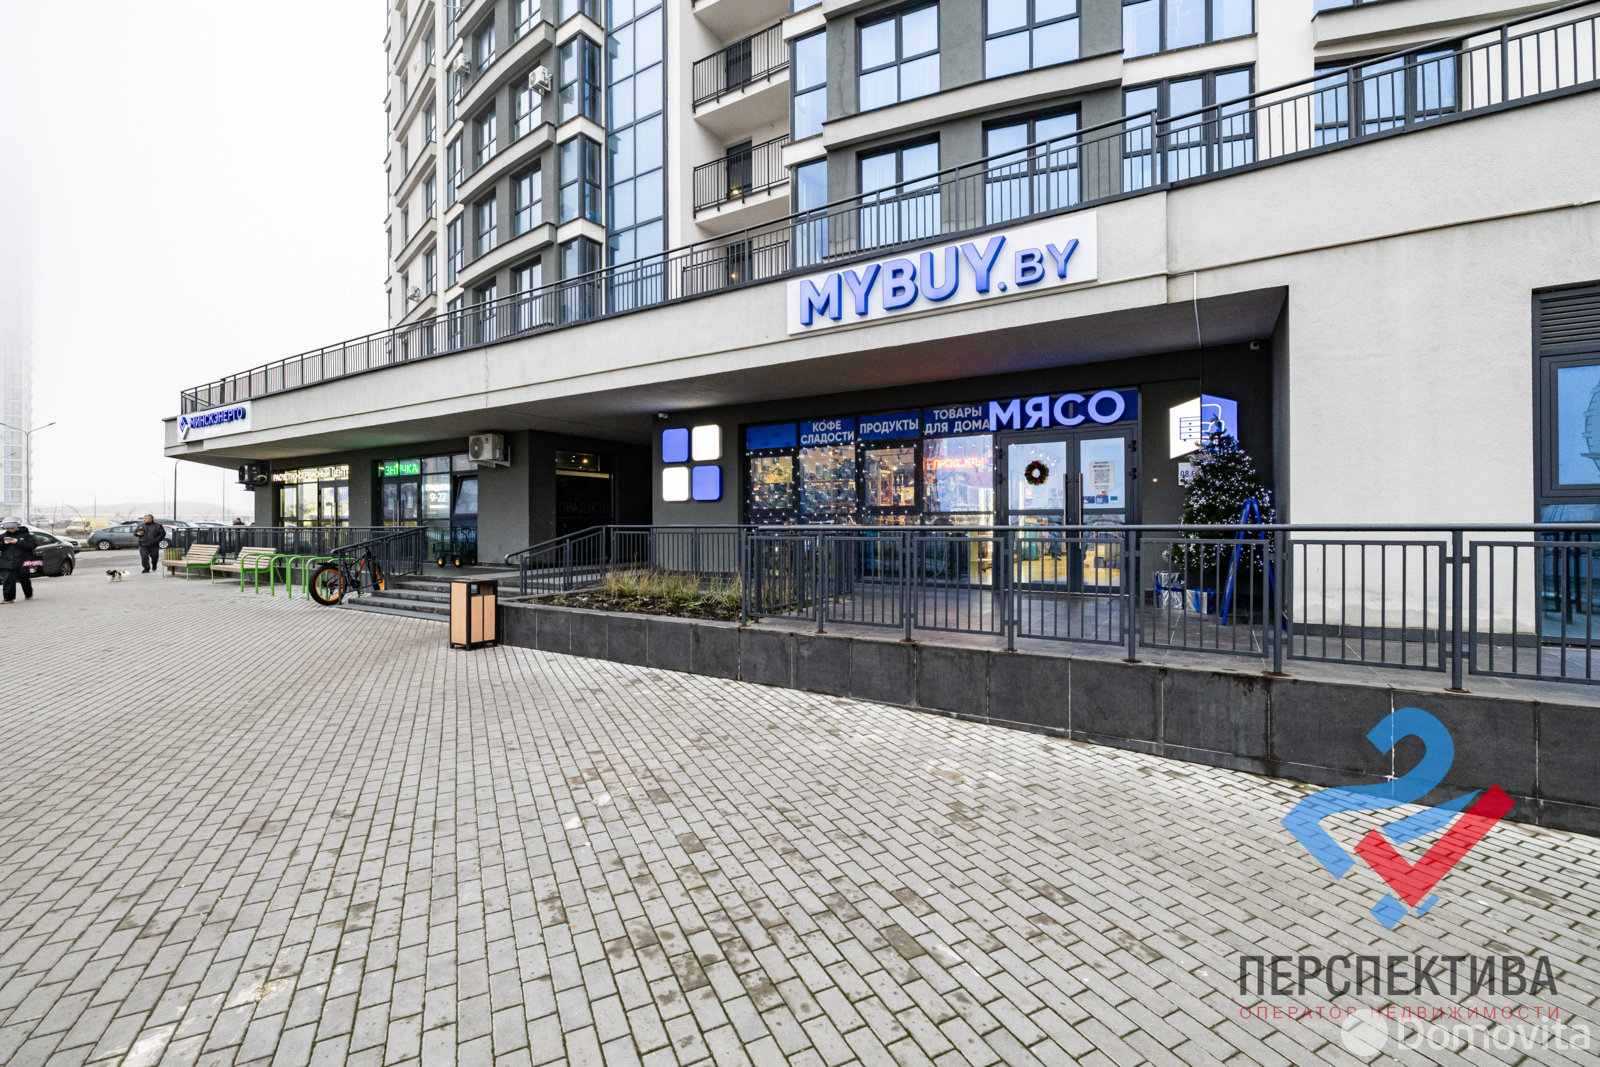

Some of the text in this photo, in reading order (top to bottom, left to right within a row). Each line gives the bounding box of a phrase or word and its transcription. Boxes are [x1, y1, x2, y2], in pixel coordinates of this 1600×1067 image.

[800, 235, 1079, 326] MYBUY.BY
[190, 406, 246, 428] МИНСКЭНЕРГО
[933, 406, 982, 420] ТОВАРЫ
[989, 390, 1125, 431] МЯСО
[812, 420, 842, 432] КОФЕ
[860, 418, 919, 434] ПРОДУКТЫ
[924, 418, 990, 436] ДЛЯ ДОМА
[801, 430, 854, 444] СЛАДОСТИ
